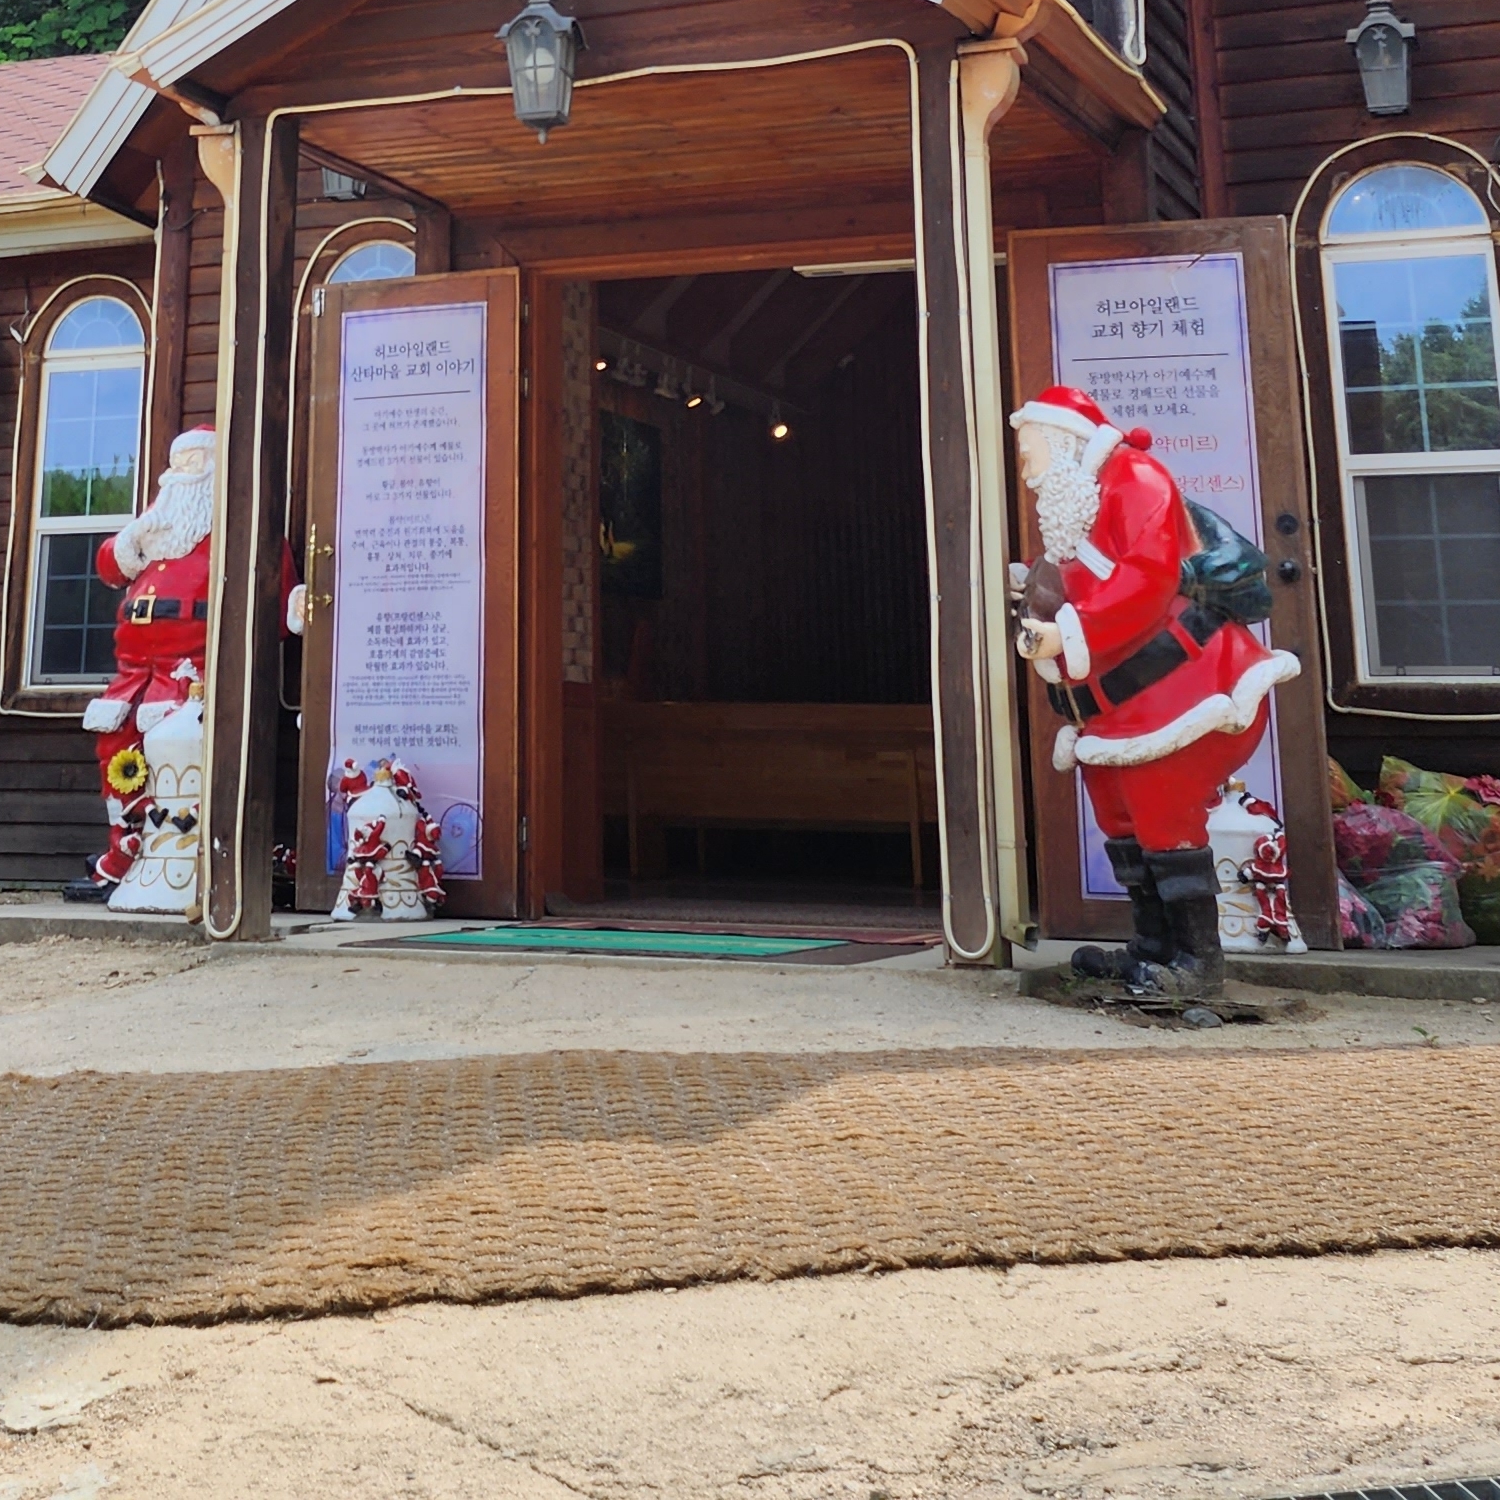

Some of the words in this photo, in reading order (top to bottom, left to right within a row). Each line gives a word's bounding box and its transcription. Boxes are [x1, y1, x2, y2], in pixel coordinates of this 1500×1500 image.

[1097, 296, 1200, 317] 허브아일랜드
[1092, 321, 1124, 339] 교회
[1132, 319, 1164, 339] 향기
[1172, 318, 1205, 336] 체험
[375, 340, 452, 360] 허브아일랜드
[351, 364, 401, 383] 산타마을
[406, 361, 431, 378] 교회
[436, 358, 475, 376] 이야기
[1088, 370, 1149, 386] 동방박사가
[1153, 367, 1217, 383] 아기예수께
[1128, 386, 1178, 401] 경배드린
[1183, 384, 1221, 399] 선물을
[1153, 402, 1196, 417] 보세요.
[1152, 434, 1218, 453] 약(미르)
[1174, 475, 1245, 493] 랑킨센스)
